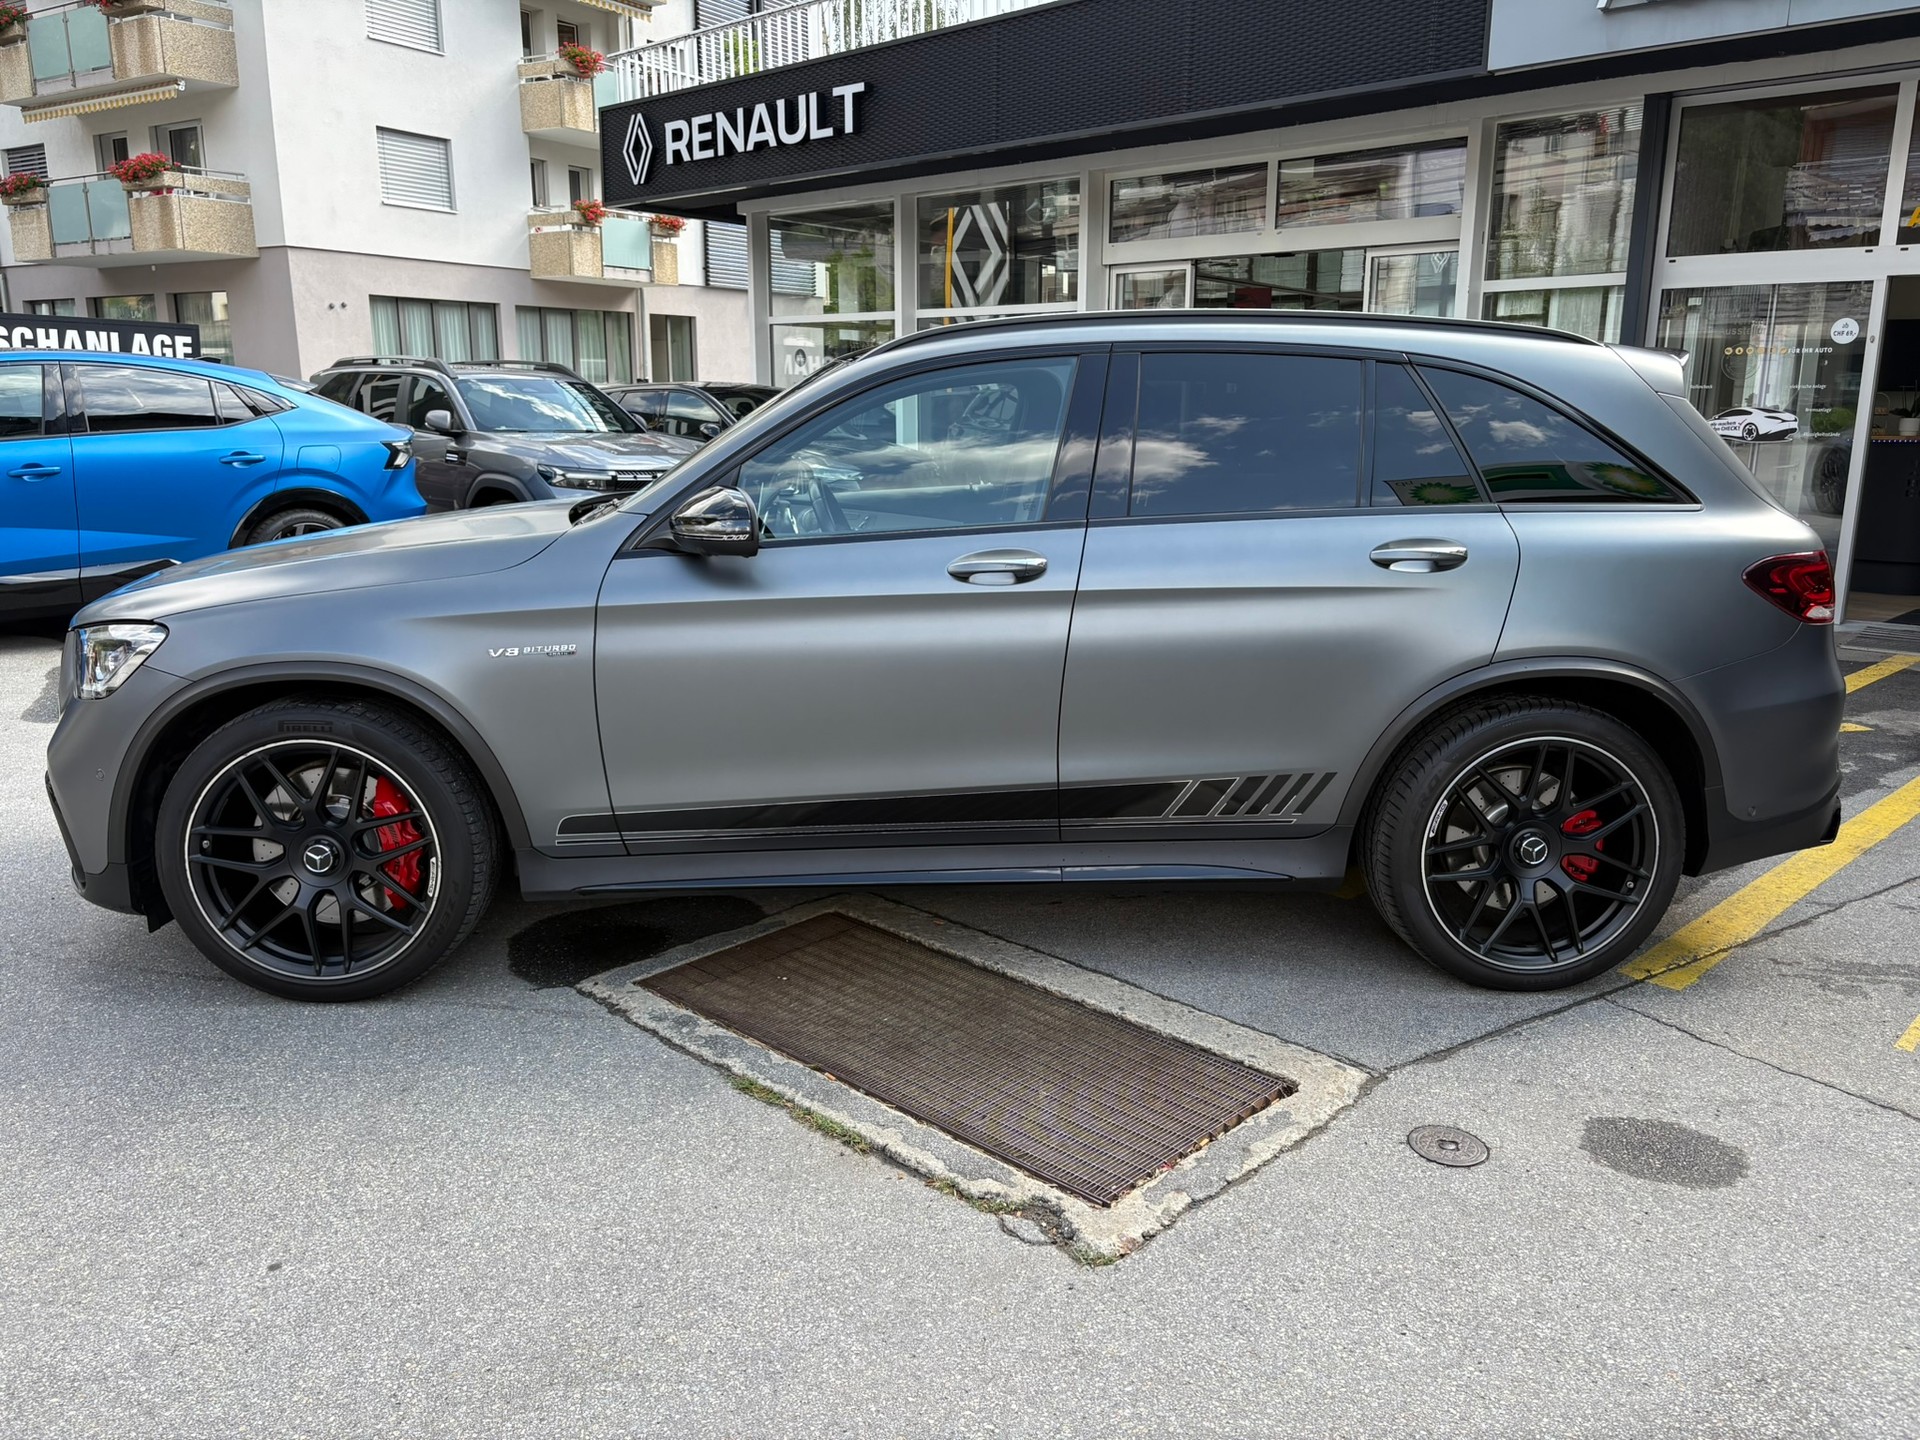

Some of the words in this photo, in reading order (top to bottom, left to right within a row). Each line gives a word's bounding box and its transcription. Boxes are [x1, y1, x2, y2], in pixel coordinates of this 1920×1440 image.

[664, 82, 865, 165] RENAULT
[1814, 346, 1833, 354] AUTO
[488, 647, 520, 658] V8
[523, 644, 577, 654] BITURBO
[277, 719, 334, 733] PIRELLI
